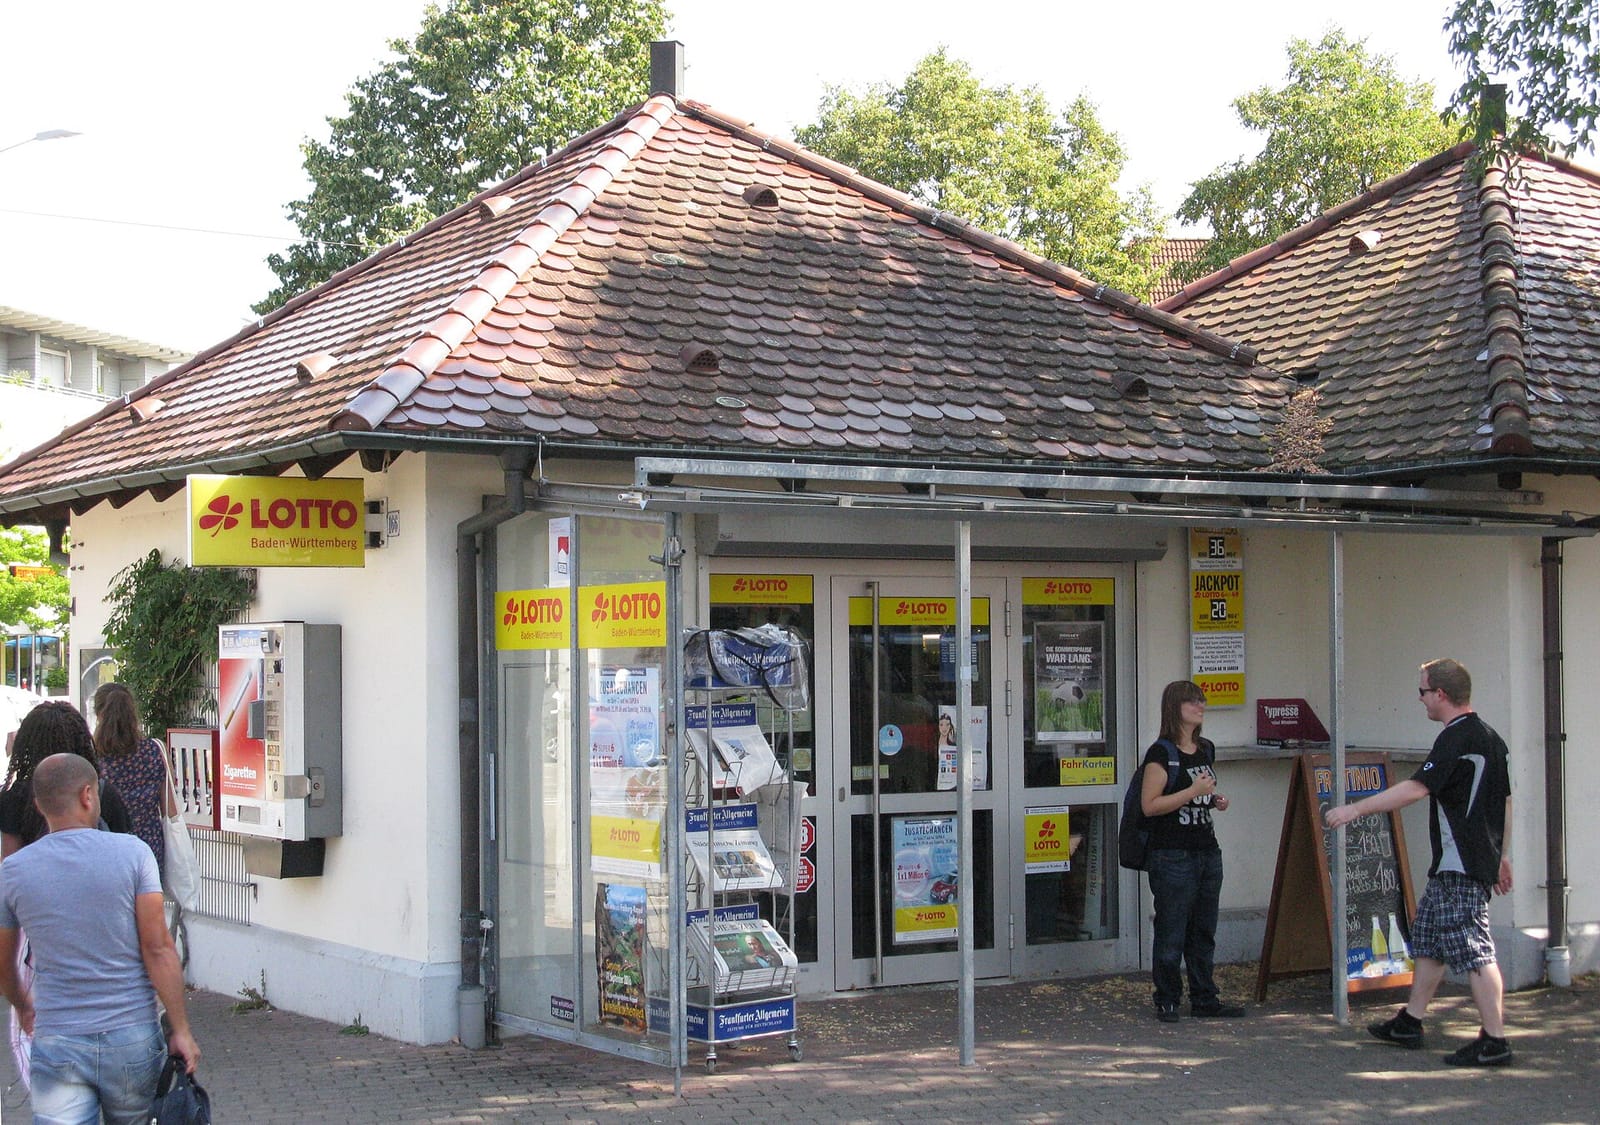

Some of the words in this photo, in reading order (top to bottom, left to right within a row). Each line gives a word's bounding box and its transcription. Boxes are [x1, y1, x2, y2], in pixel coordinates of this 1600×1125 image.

[251, 498, 358, 530] LOTTO
[251, 537, 357, 550] Baden-Württemberg
[750, 579, 788, 592] LOTTO
[1058, 582, 1092, 594] LOTTO
[1195, 575, 1241, 592] JACKPOT
[521, 598, 563, 625] LOTTO
[612, 593, 661, 620] LOTTO
[911, 603, 947, 614] LOTTO
[1211, 601, 1227, 618] 20
[1046, 653, 1066, 663] WAR
[1068, 653, 1092, 663] LANG.
[1211, 682, 1239, 692] LOTTO
[1061, 758, 1113, 769] FahrKarten
[223, 764, 257, 780] Zigaretten
[618, 829, 640, 843] LOTTO
[1034, 839, 1060, 850] LOTTO
[924, 911, 945, 920] LOTTO
[719, 1013, 755, 1028] Frankfurter
[754, 1006, 789, 1023] Allgemeine
